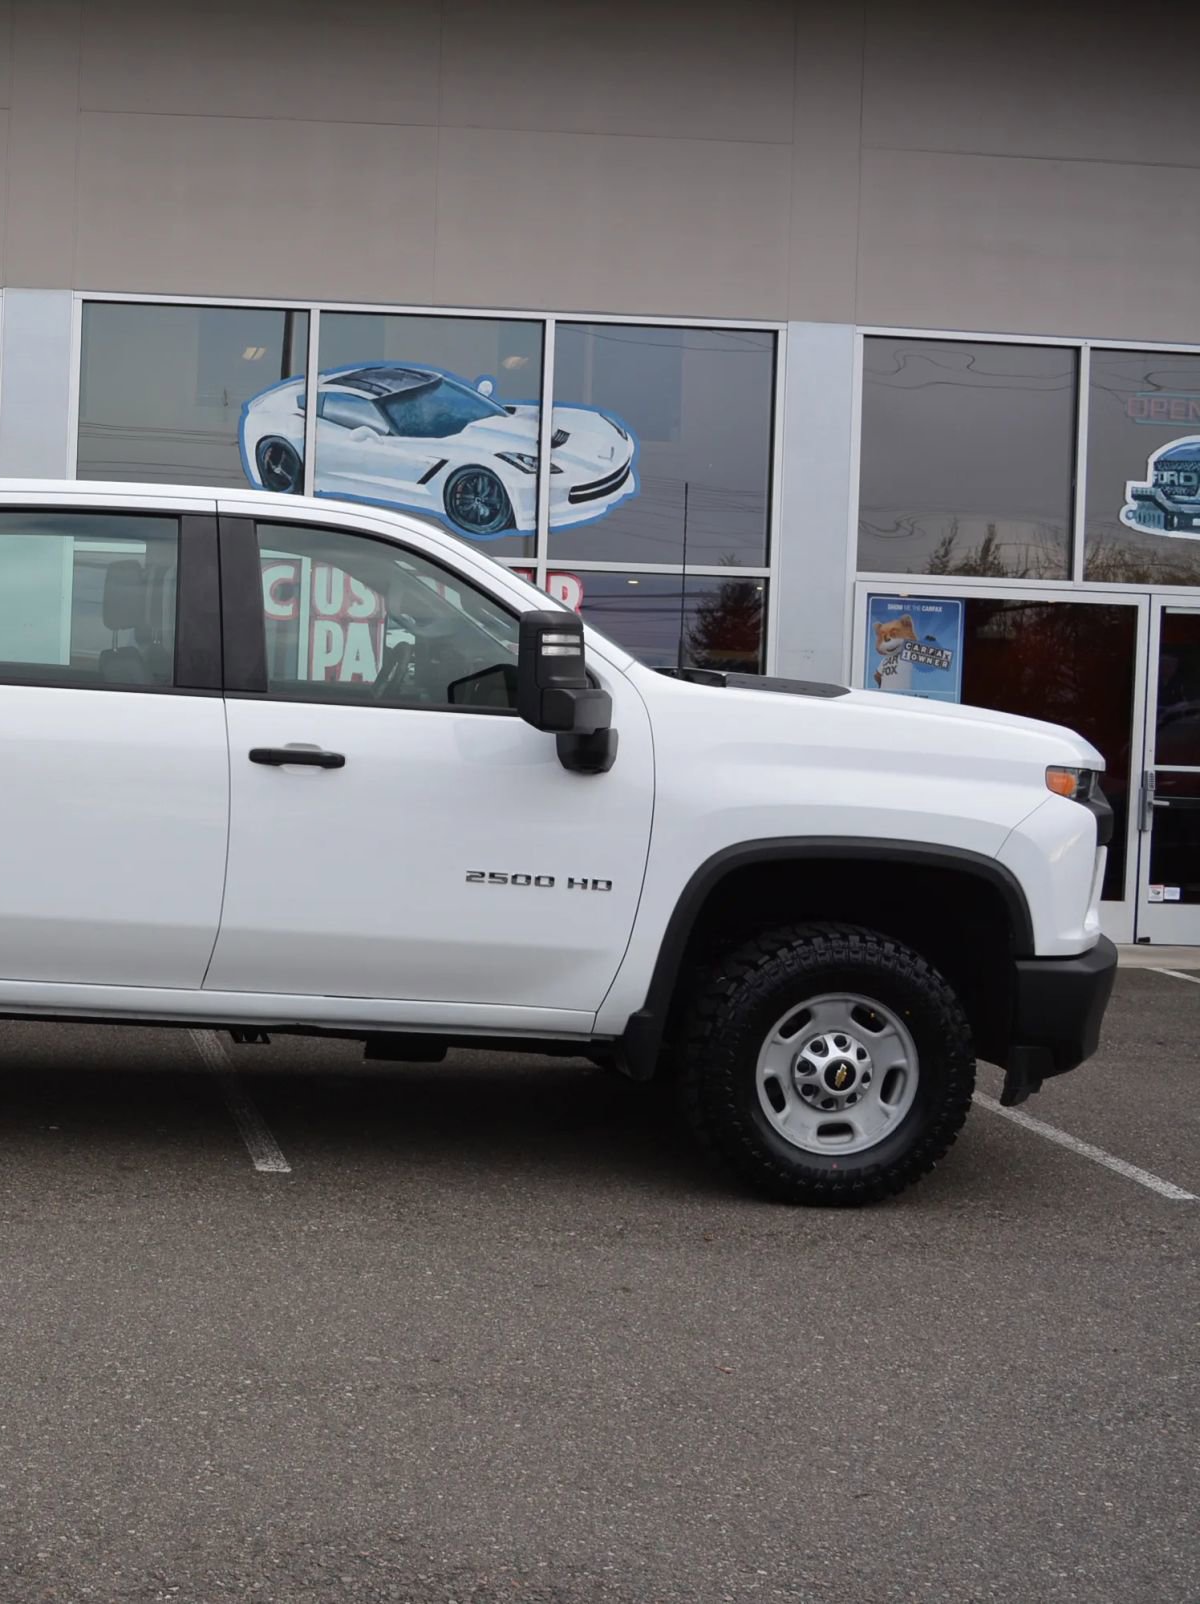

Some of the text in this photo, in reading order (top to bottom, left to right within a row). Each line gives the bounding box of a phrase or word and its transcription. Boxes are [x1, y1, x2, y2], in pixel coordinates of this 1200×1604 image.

[905, 642, 952, 660] CARFAX
[911, 653, 949, 668] OWNER
[465, 870, 613, 892] 2500 HD
